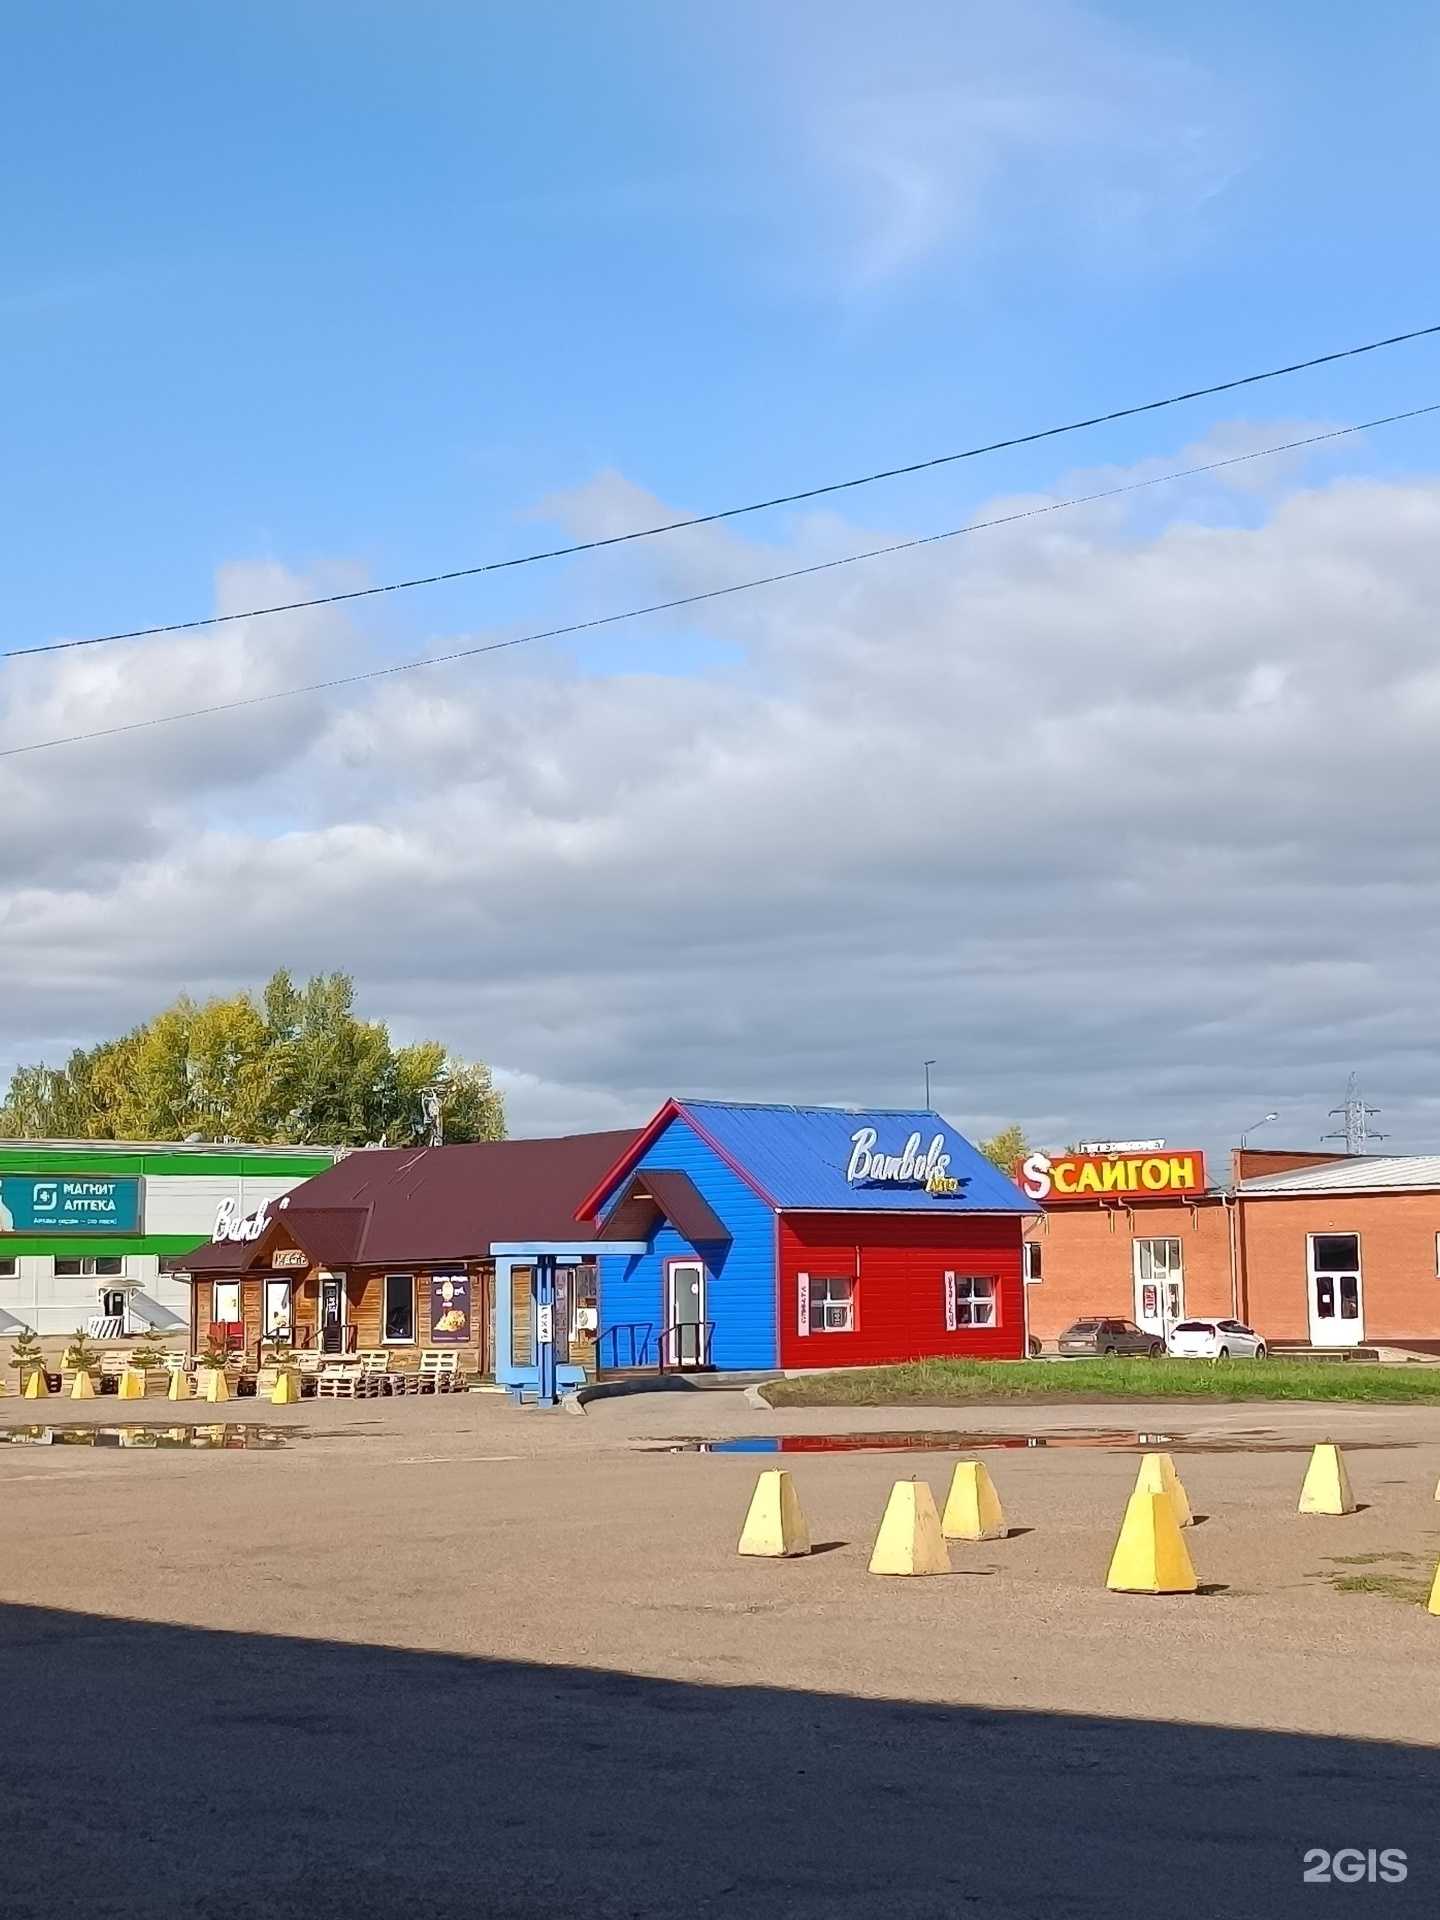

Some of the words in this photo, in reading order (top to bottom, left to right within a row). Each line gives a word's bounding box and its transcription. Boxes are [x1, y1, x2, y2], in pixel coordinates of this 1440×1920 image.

[1050, 1153, 1196, 1194] САЙГОН
[63, 1183, 116, 1195] МАГНИТ
[64, 1199, 117, 1211] АПТЕКА
